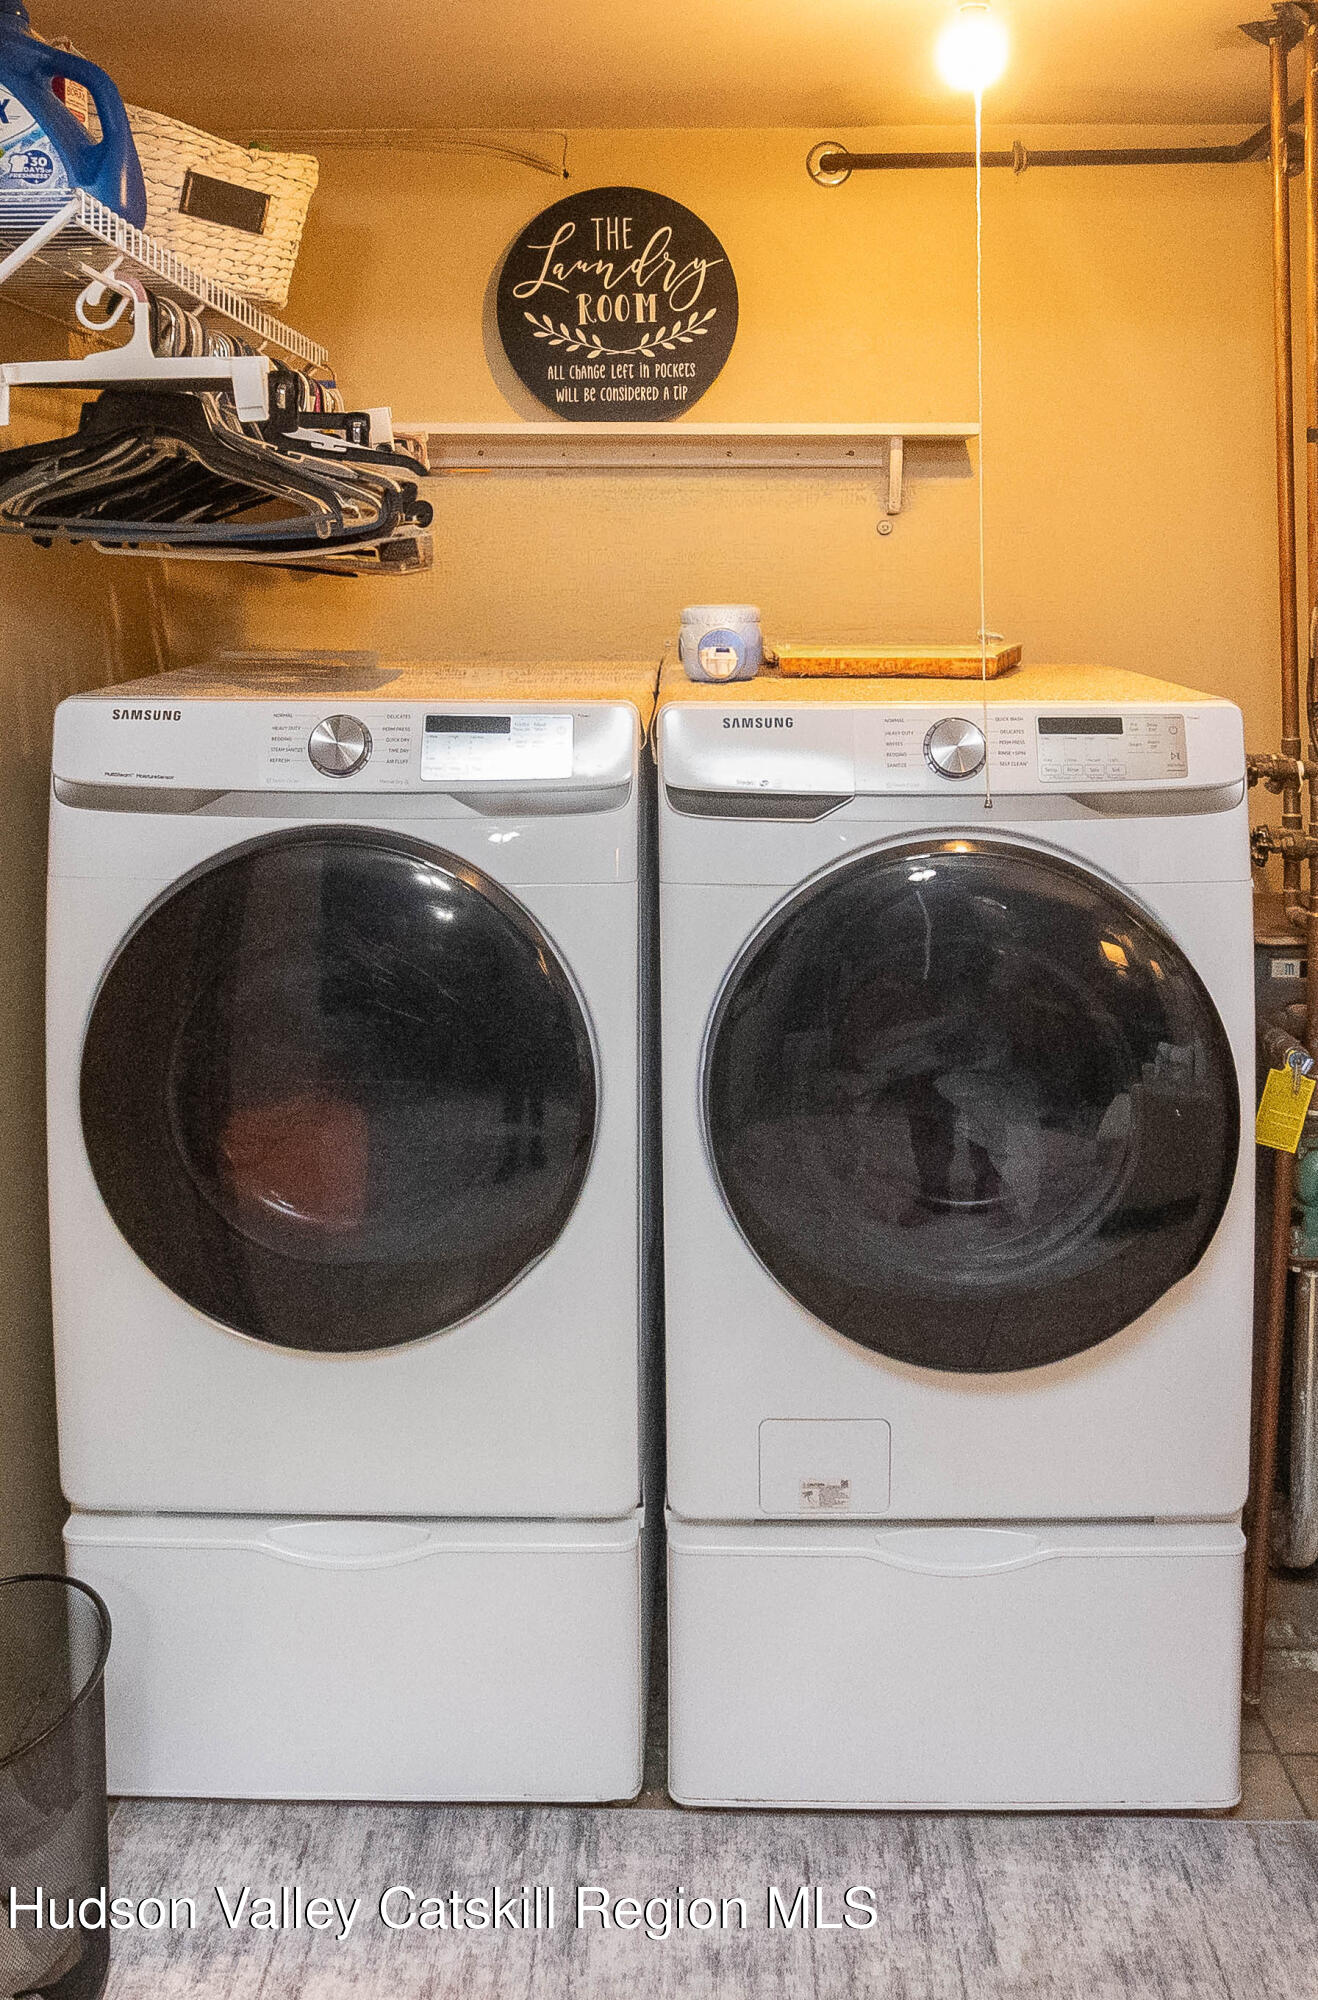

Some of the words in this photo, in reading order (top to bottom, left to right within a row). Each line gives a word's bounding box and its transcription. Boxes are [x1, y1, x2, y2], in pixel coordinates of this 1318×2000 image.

[30, 157, 47, 167] 30
[591, 217, 632, 251] THE
[513, 221, 724, 312] Laundry
[576, 293, 658, 326] ROOM
[547, 365, 565, 380] ALL
[663, 386, 670, 400] A
[112, 709, 182, 721] SAMSUNG
[722, 717, 794, 729] SAMSUNG
